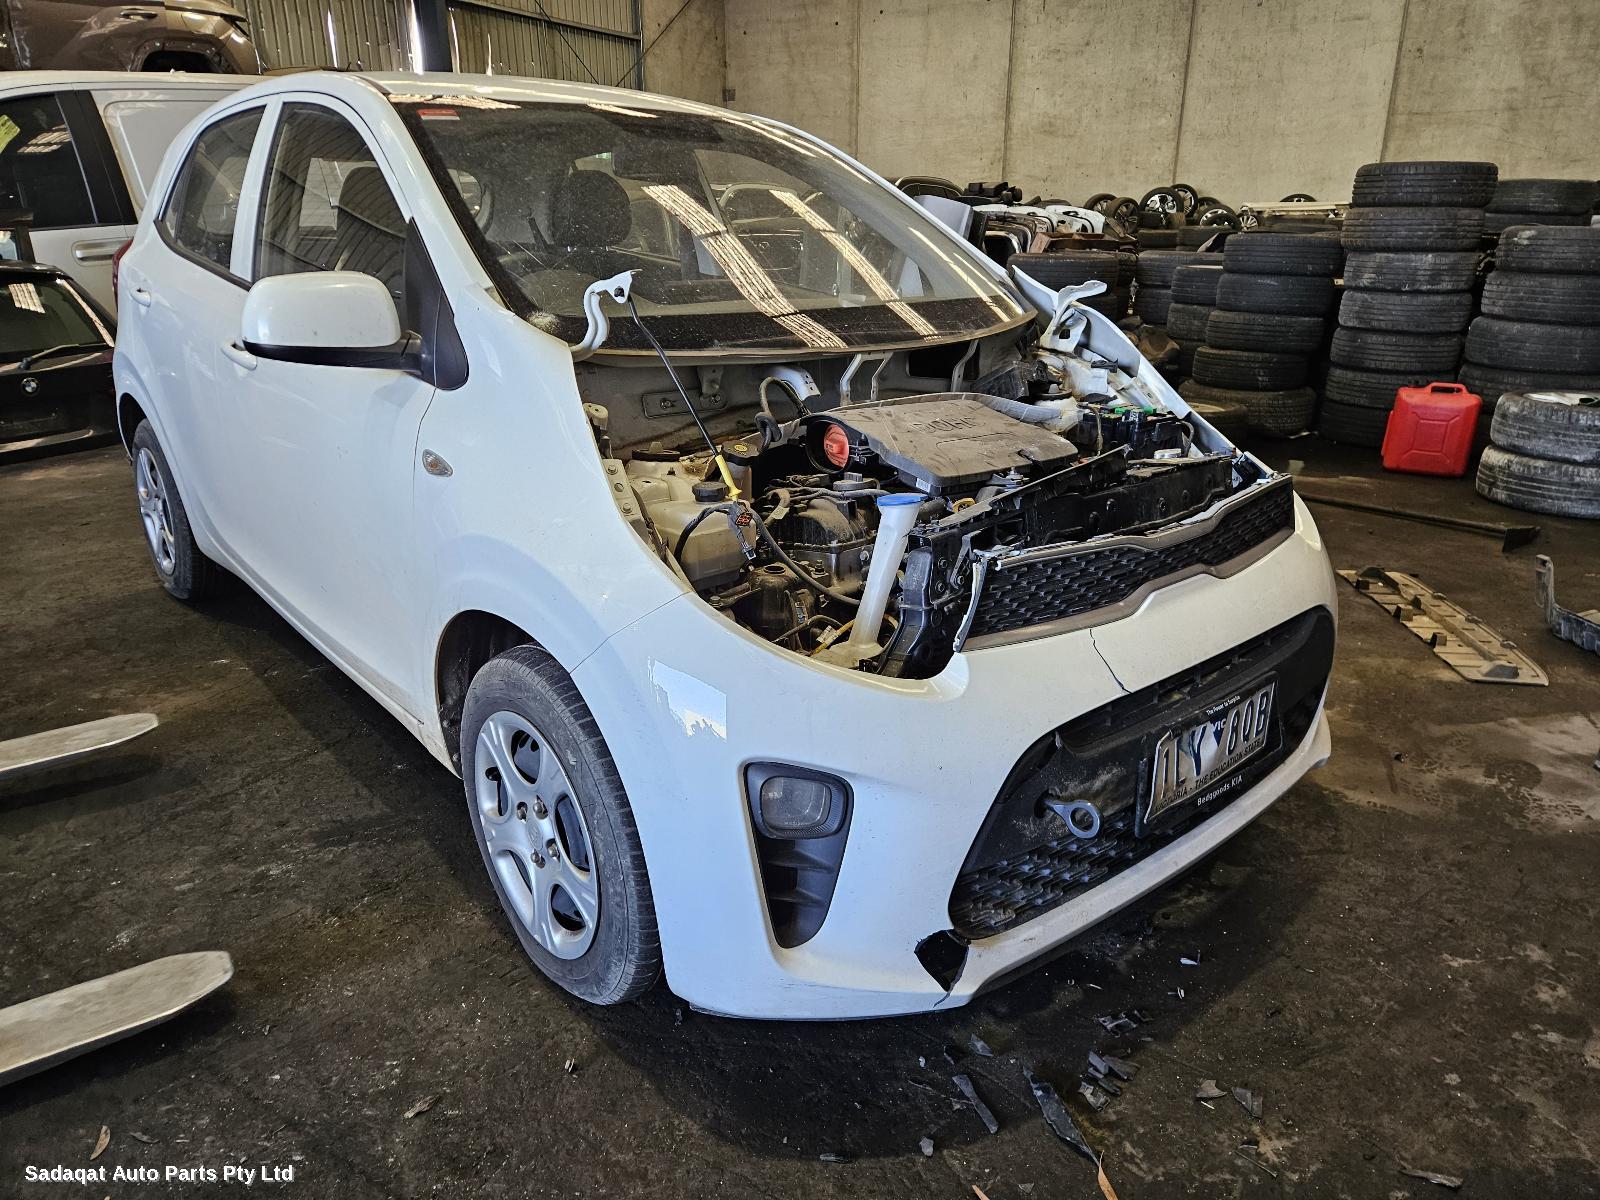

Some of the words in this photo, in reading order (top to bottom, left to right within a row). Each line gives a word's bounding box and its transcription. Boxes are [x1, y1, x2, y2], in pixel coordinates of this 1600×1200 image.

[1212, 718, 1227, 733] VIC
[1195, 774, 1209, 790] THE
[1209, 751, 1243, 779] EDUCATION
[1243, 738, 1262, 757] STATE
[1231, 775, 1243, 788] KIA
